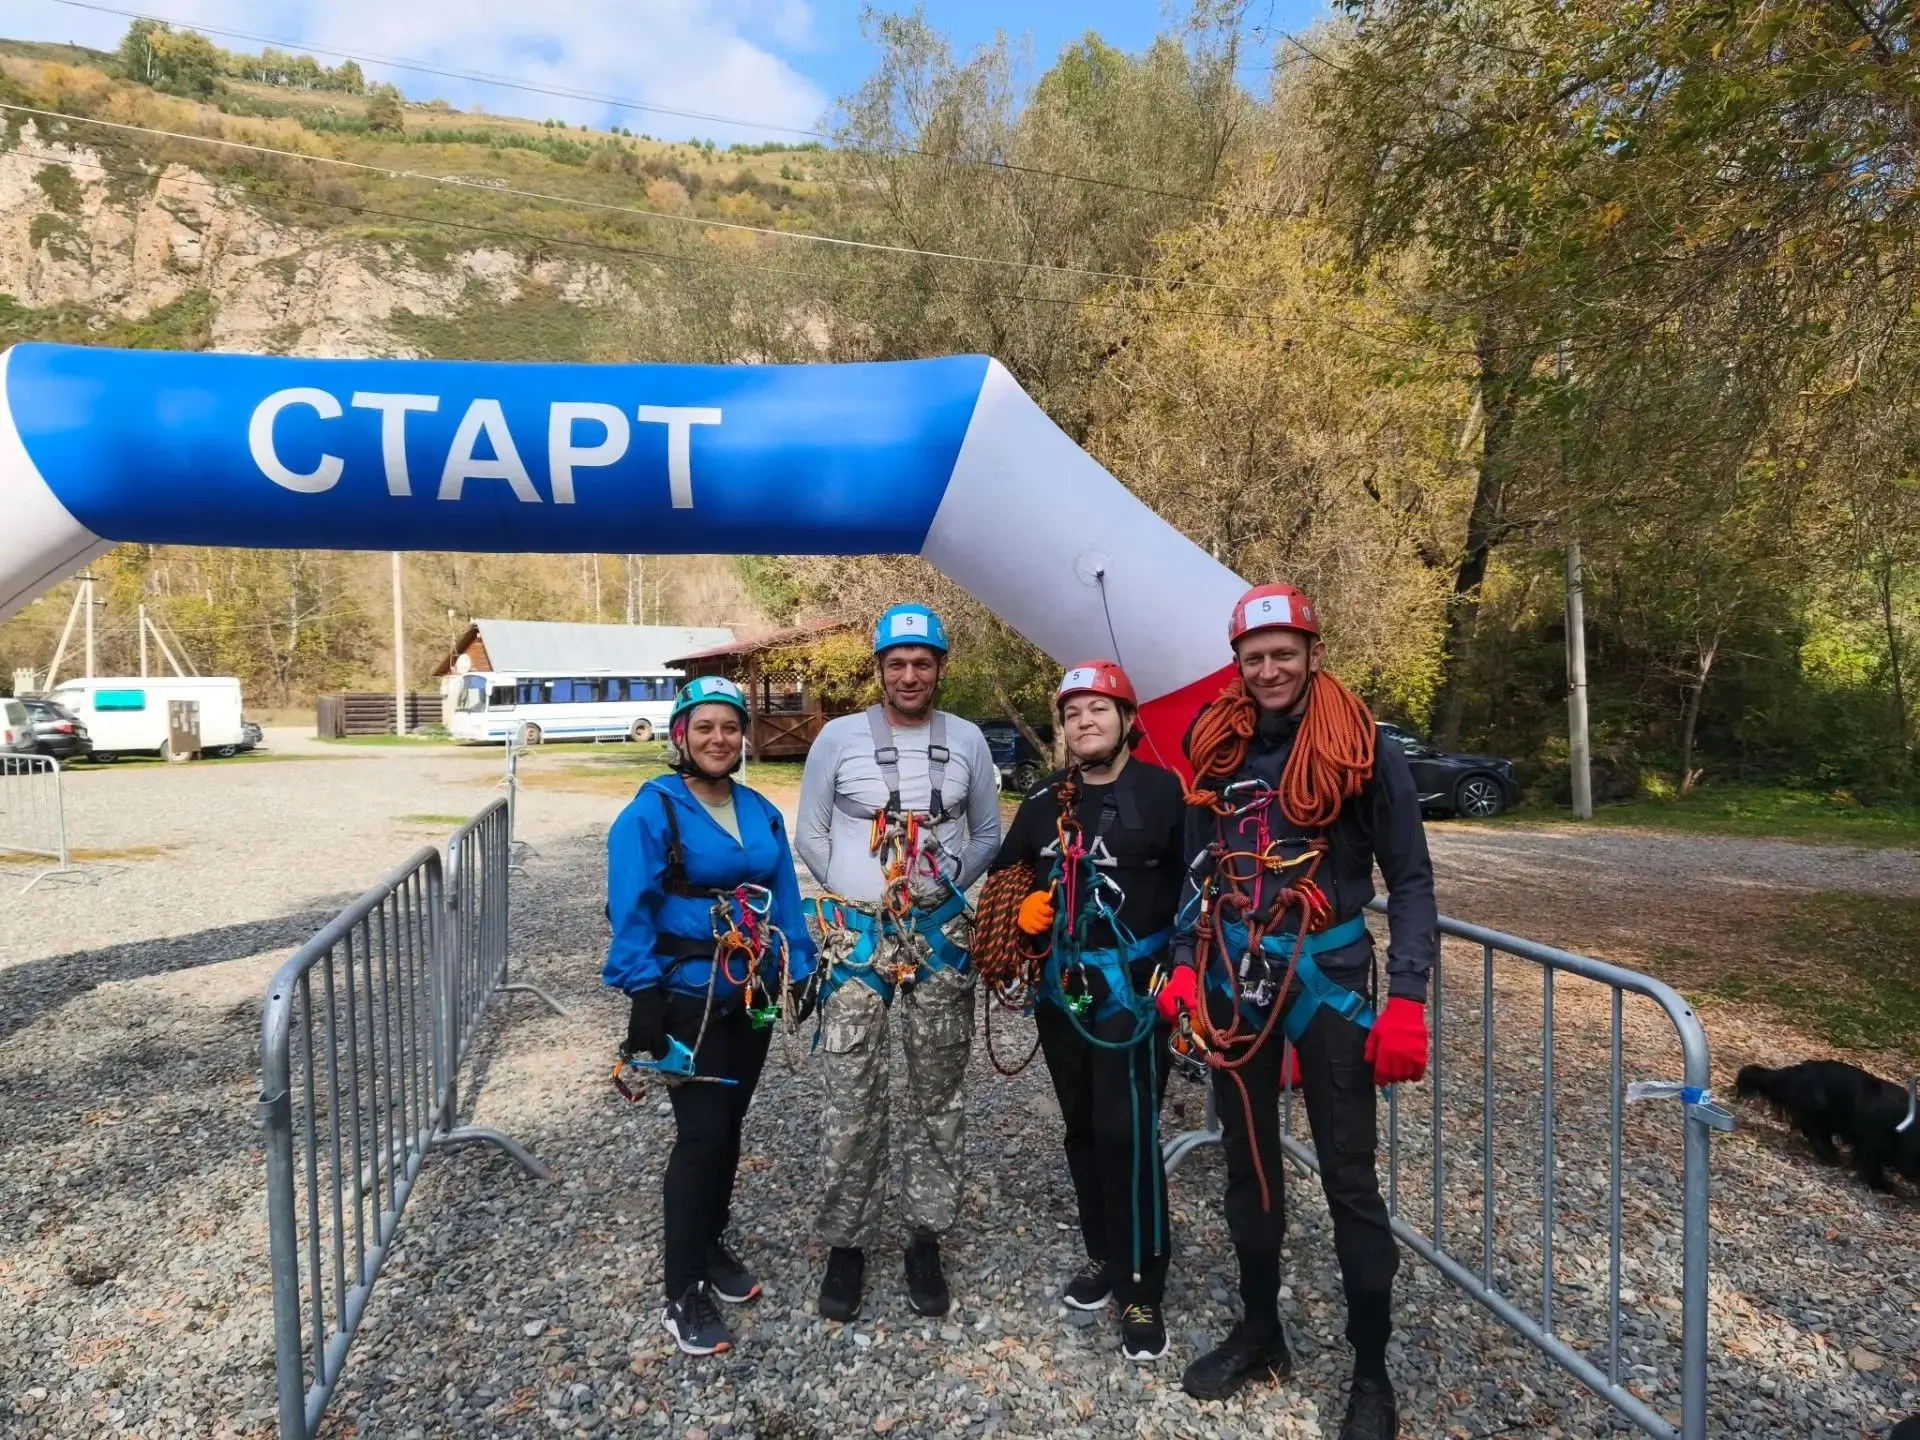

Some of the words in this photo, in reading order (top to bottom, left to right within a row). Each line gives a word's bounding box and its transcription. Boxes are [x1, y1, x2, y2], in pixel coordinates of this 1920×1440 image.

[248, 387, 723, 510] СТАРТ
[1262, 600, 1271, 612] 5
[906, 616, 913, 625] 5
[1073, 671, 1080, 680] 5
